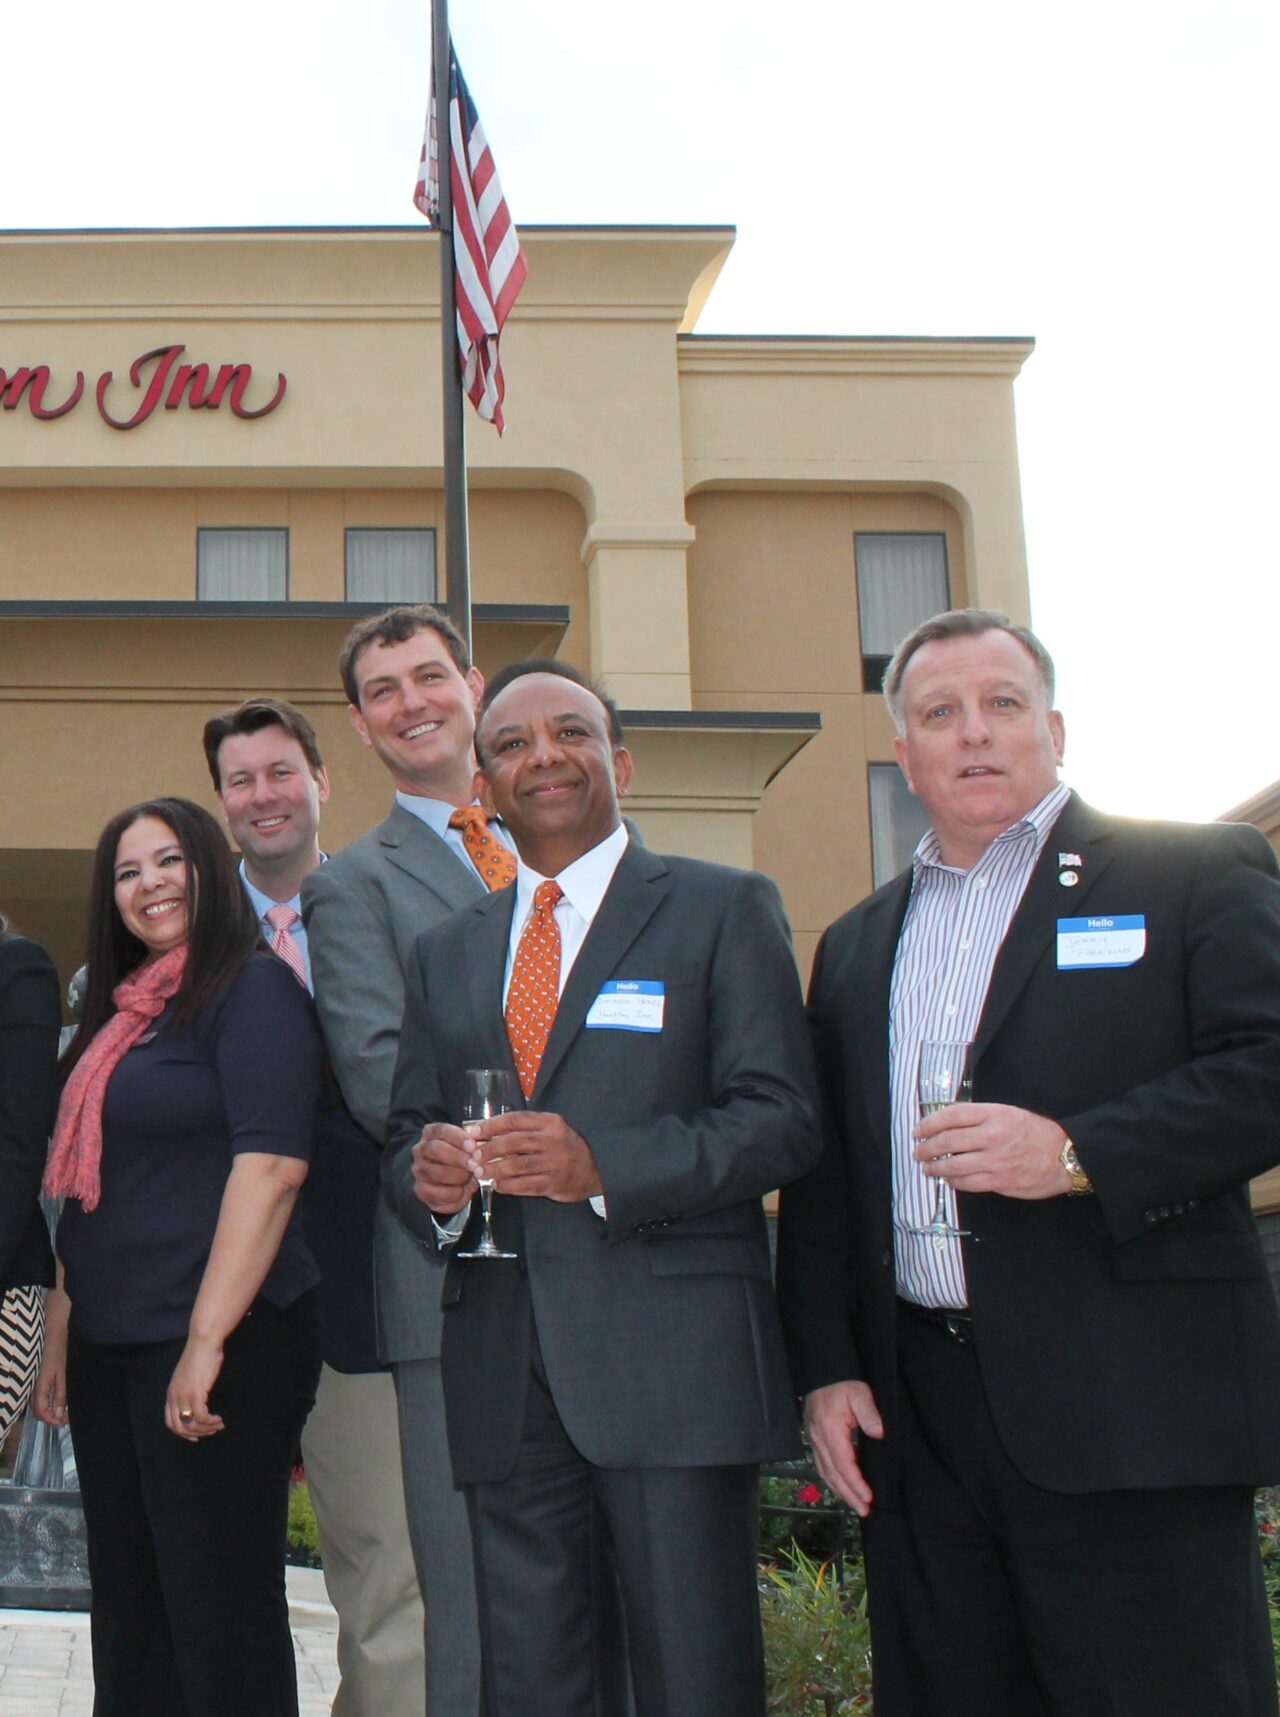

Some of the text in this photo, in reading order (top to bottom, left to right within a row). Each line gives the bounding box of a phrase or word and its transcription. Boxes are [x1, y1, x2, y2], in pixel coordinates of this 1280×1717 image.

[96, 343, 288, 431] Inn
[1087, 918, 1114, 928] Hello
[616, 982, 639, 991] Hello
